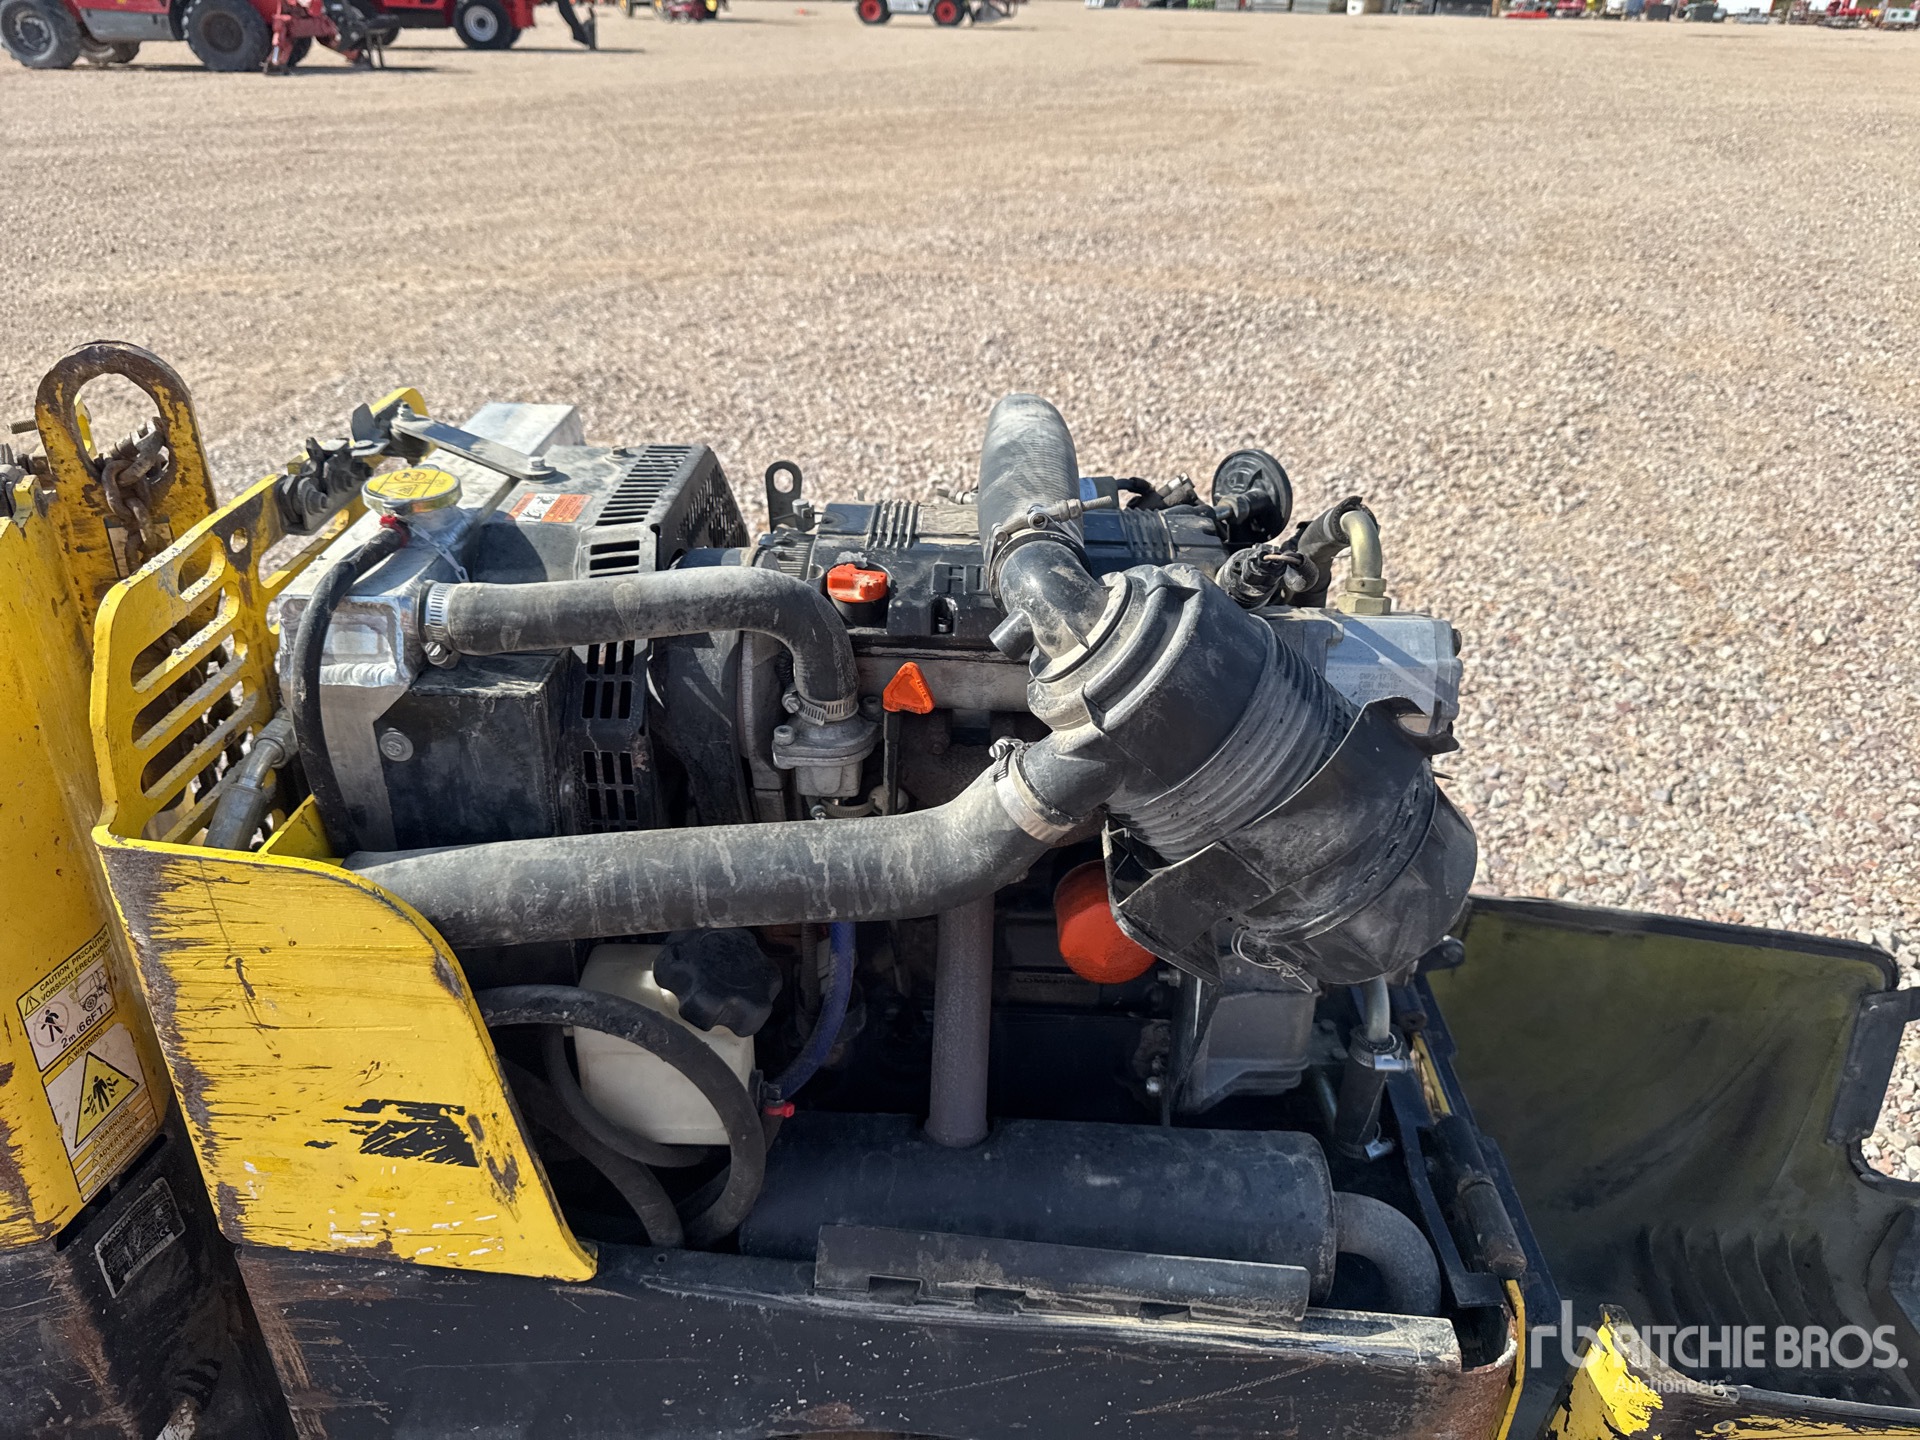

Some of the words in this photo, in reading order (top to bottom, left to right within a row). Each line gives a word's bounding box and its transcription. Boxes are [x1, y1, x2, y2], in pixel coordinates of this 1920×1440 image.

[40, 964, 70, 992] CAUTION
[71, 928, 108, 966] PRECAUTION
[41, 971, 75, 1001] VORSICHT
[61, 1033, 76, 1049] 2m
[73, 1028, 104, 1057] WARNING
[98, 1116, 139, 1158] ADVERTENCIA
[99, 1108, 130, 1141] WARNUNG
[100, 1126, 145, 1174] AVERTISSEMENT
